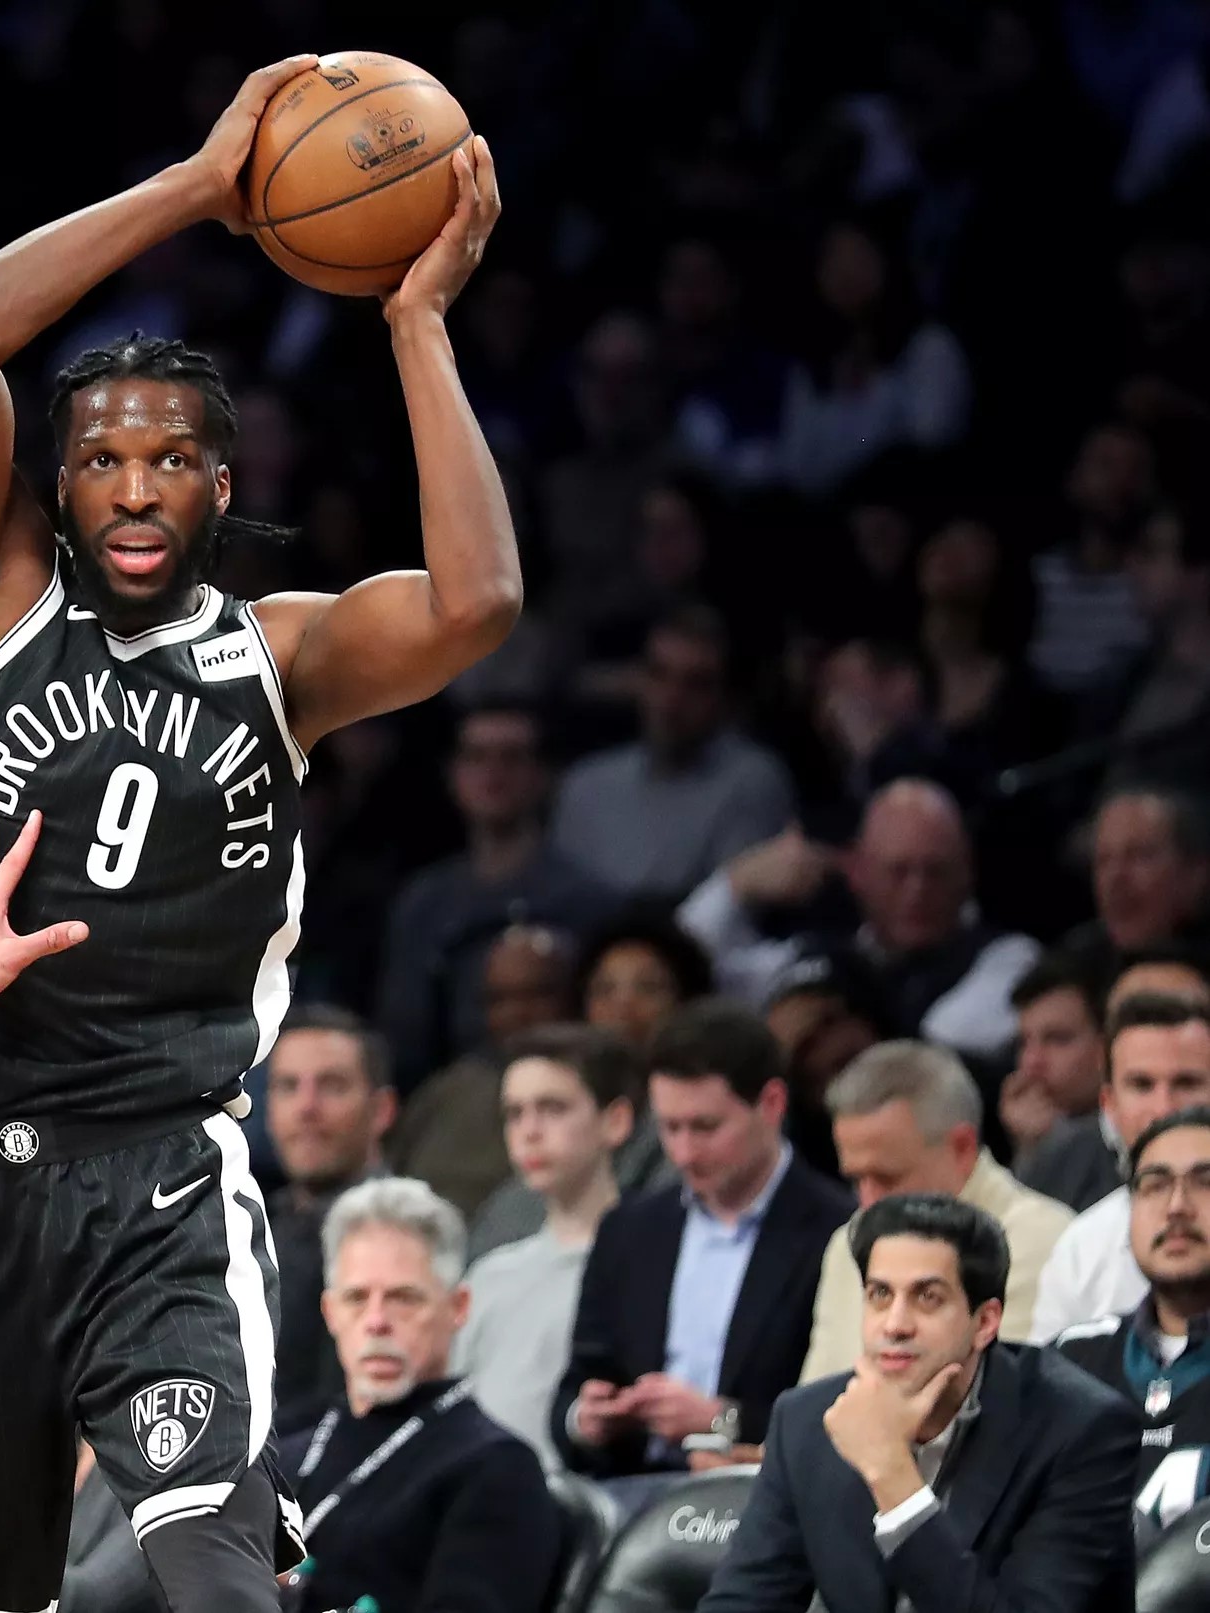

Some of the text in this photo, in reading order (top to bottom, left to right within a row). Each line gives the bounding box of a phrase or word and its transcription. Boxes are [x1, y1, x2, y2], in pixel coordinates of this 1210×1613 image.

[200, 646, 249, 668] infor
[200, 722, 274, 870] NETS
[85, 762, 160, 890] 9
[13, 1133, 24, 1153] B
[135, 1383, 208, 1432] NETS
[159, 1426, 172, 1458] B
